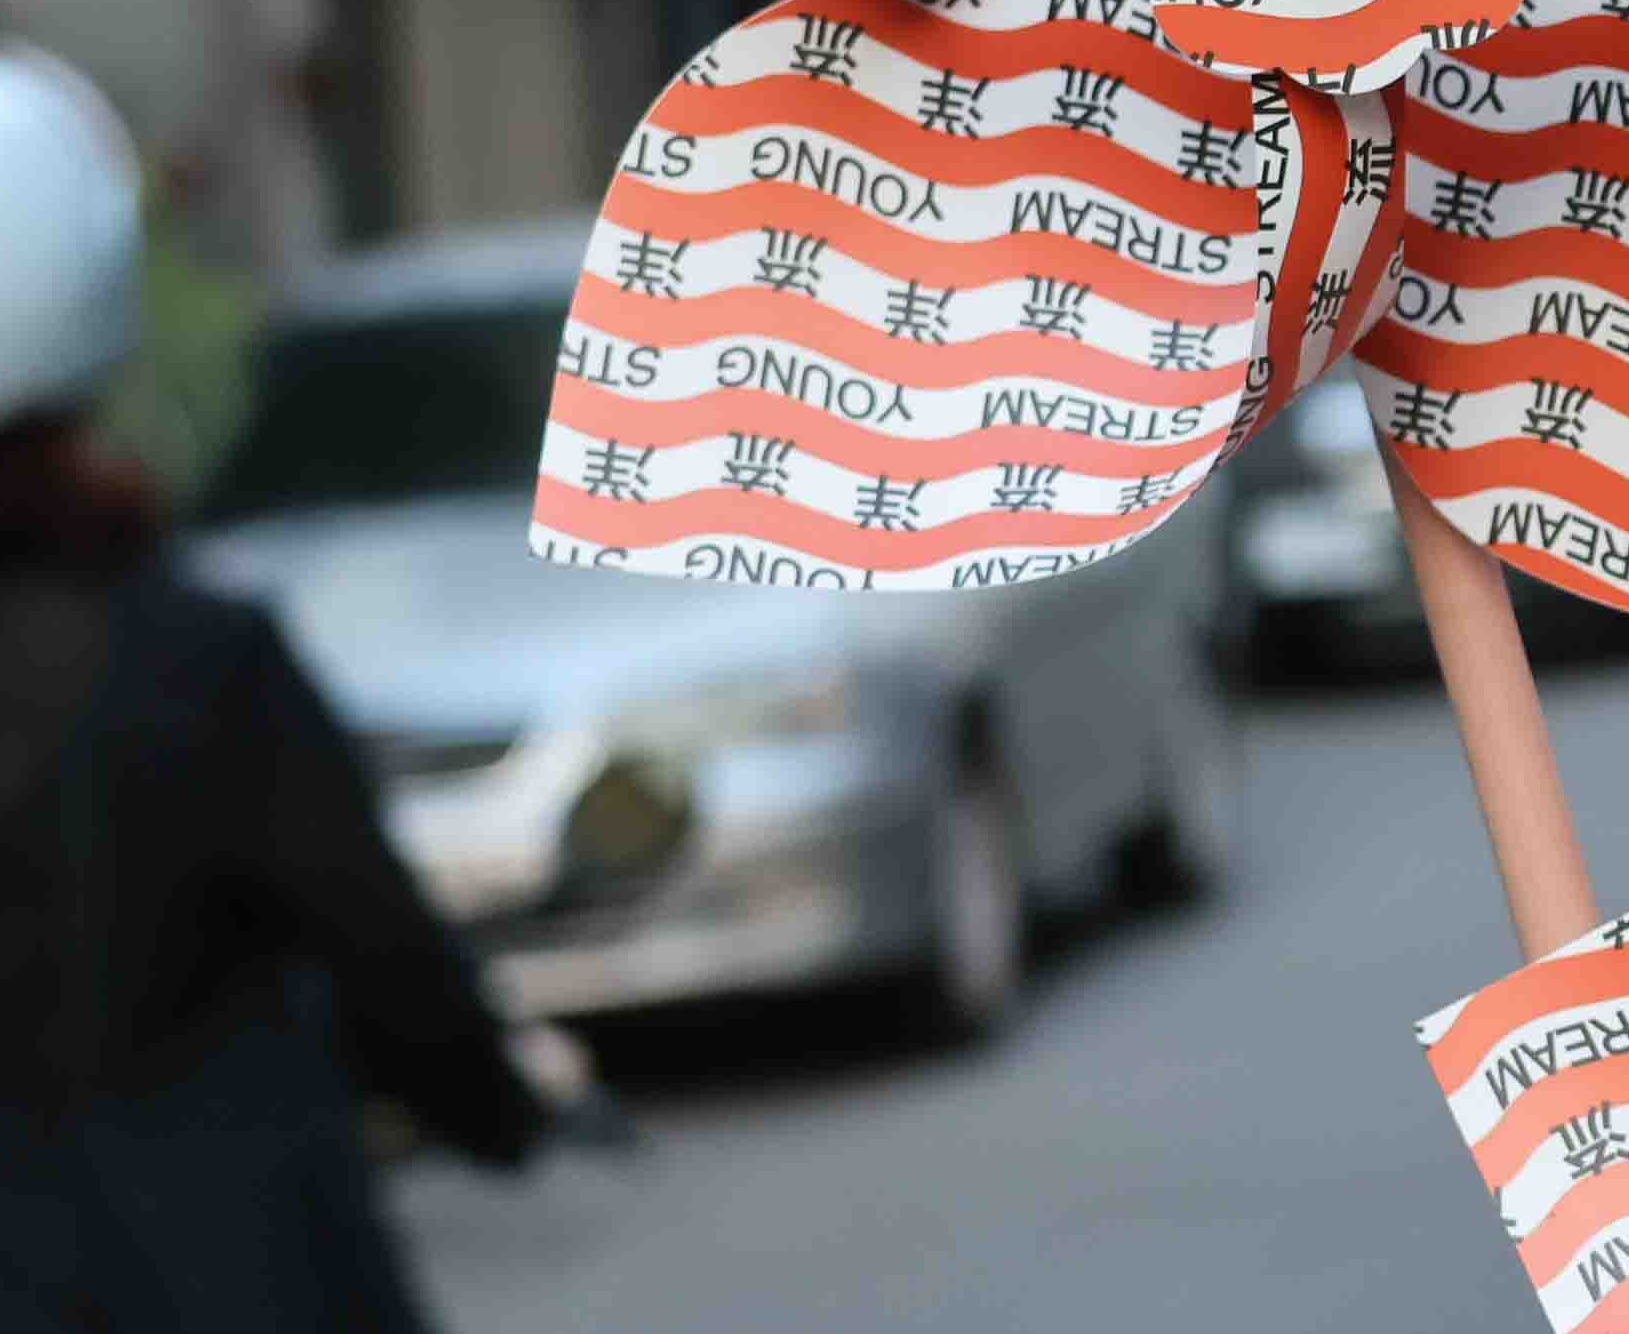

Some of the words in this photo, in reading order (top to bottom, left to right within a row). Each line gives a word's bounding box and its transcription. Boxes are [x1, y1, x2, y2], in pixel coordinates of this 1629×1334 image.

[751, 137, 943, 222] YOUNG
[1010, 191, 1232, 274] STREAM
[562, 338, 661, 387] STR
[717, 347, 911, 422] YOUNG
[980, 390, 1204, 441] STREAM
